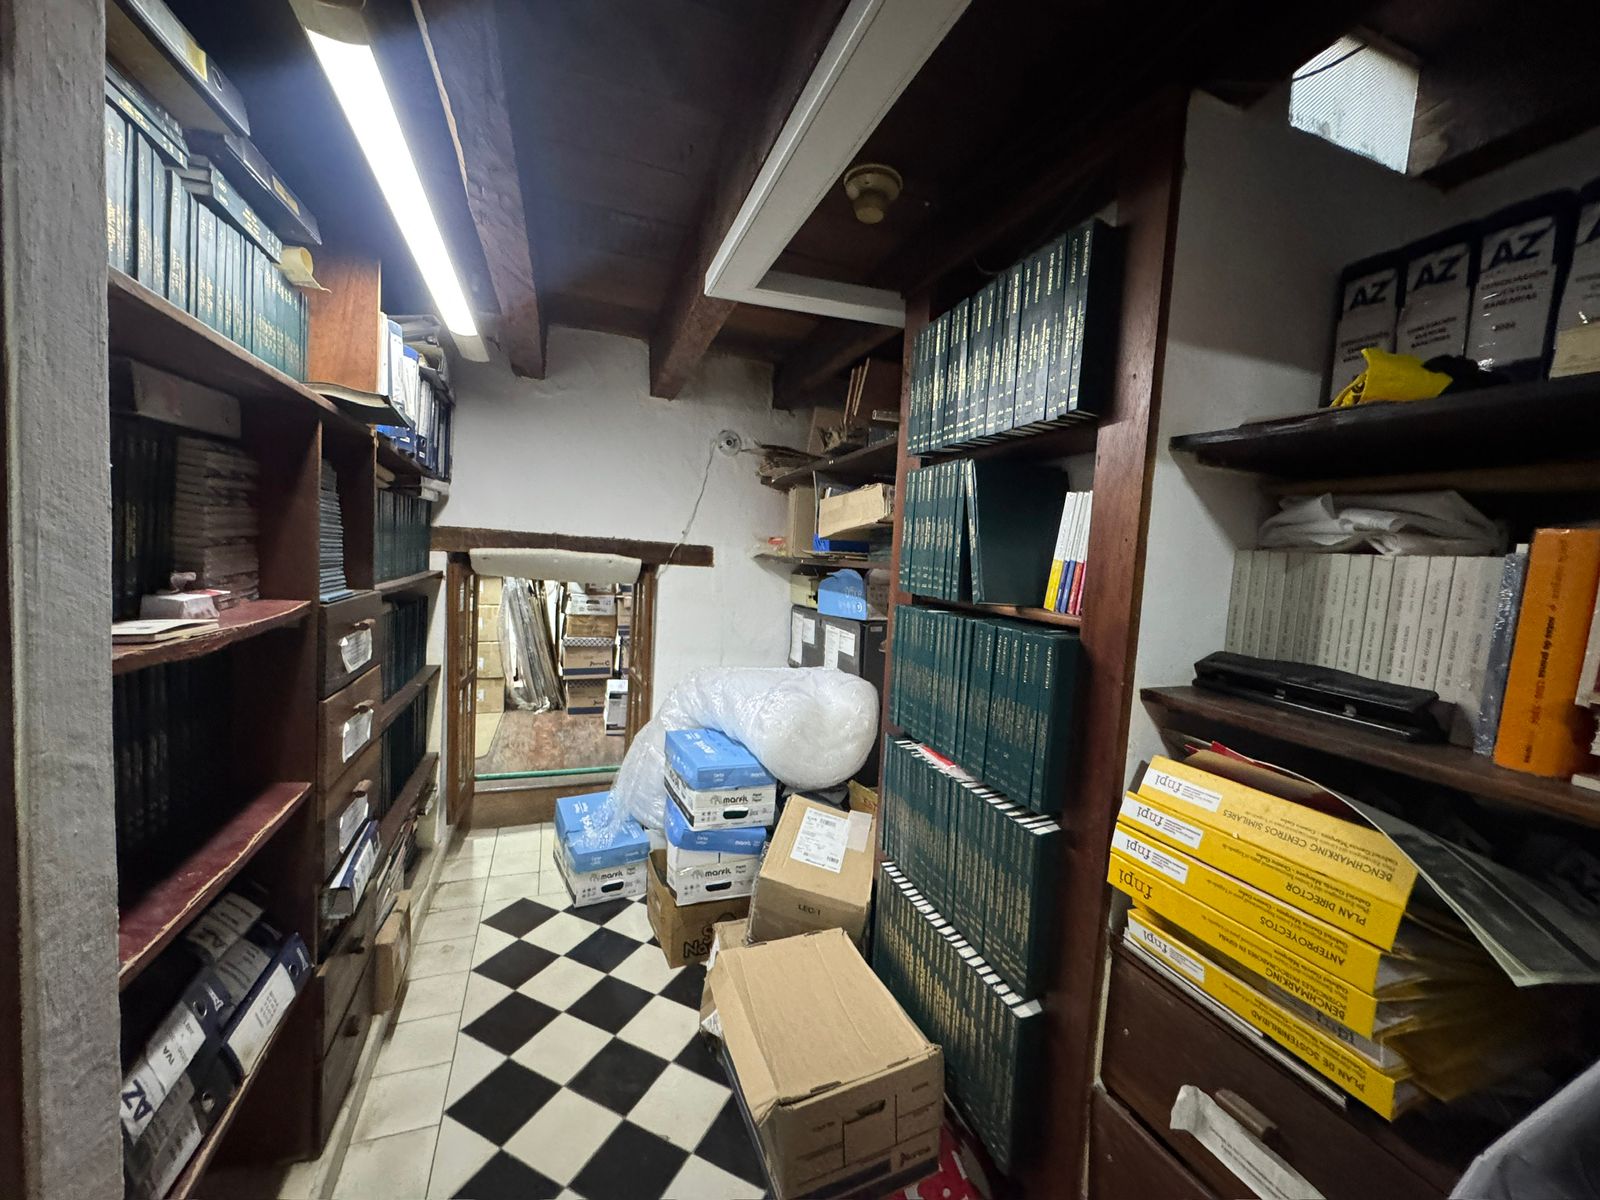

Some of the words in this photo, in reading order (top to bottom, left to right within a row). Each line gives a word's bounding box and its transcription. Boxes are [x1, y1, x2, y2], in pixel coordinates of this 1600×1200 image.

[1488, 227, 1553, 270] AZ
[1413, 254, 1466, 291] AZ
[1350, 279, 1394, 312] AZ
[1155, 775, 1182, 793] fnpi
[722, 796, 749, 804] marfil
[1137, 807, 1164, 826] fnpi
[1222, 808, 1263, 830] SIMILARES
[1263, 824, 1307, 848] CENTROS
[1126, 839, 1151, 860] fnpi
[1308, 842, 1393, 882] BENCHMARKING
[600, 871, 624, 880] marfil
[704, 868, 732, 877] marfil
[1119, 869, 1152, 899] fnpi
[1284, 881, 1336, 911] DIRECTOR
[1337, 906, 1367, 926] PLAN
[1143, 930, 1168, 954] fnpi
[1257, 915, 1345, 966] ANTEPROYECTOS
[1263, 966, 1347, 1020] BENCHMARKING
[1248, 1008, 1322, 1061] SOSTENIBILIDAD
[1319, 1056, 1337, 1072] DE
[1334, 1066, 1367, 1092] PLAN
[122, 1079, 153, 1122] AZ
